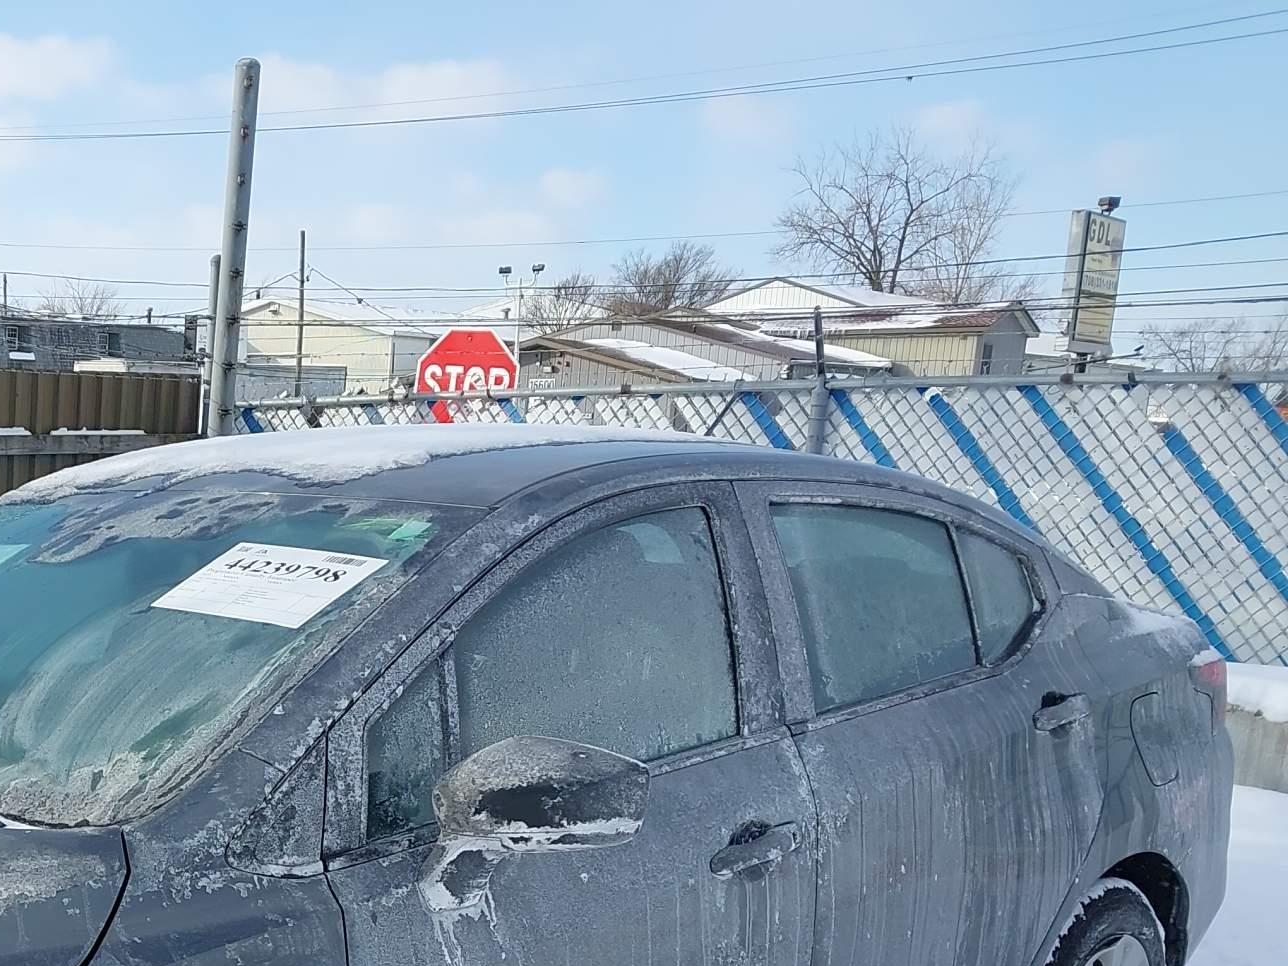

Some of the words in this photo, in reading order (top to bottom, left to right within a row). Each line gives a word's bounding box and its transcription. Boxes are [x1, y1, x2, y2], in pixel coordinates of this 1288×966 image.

[1089, 219, 1111, 246] GDL
[424, 364, 510, 393] STOP
[224, 558, 347, 583] 44239798
